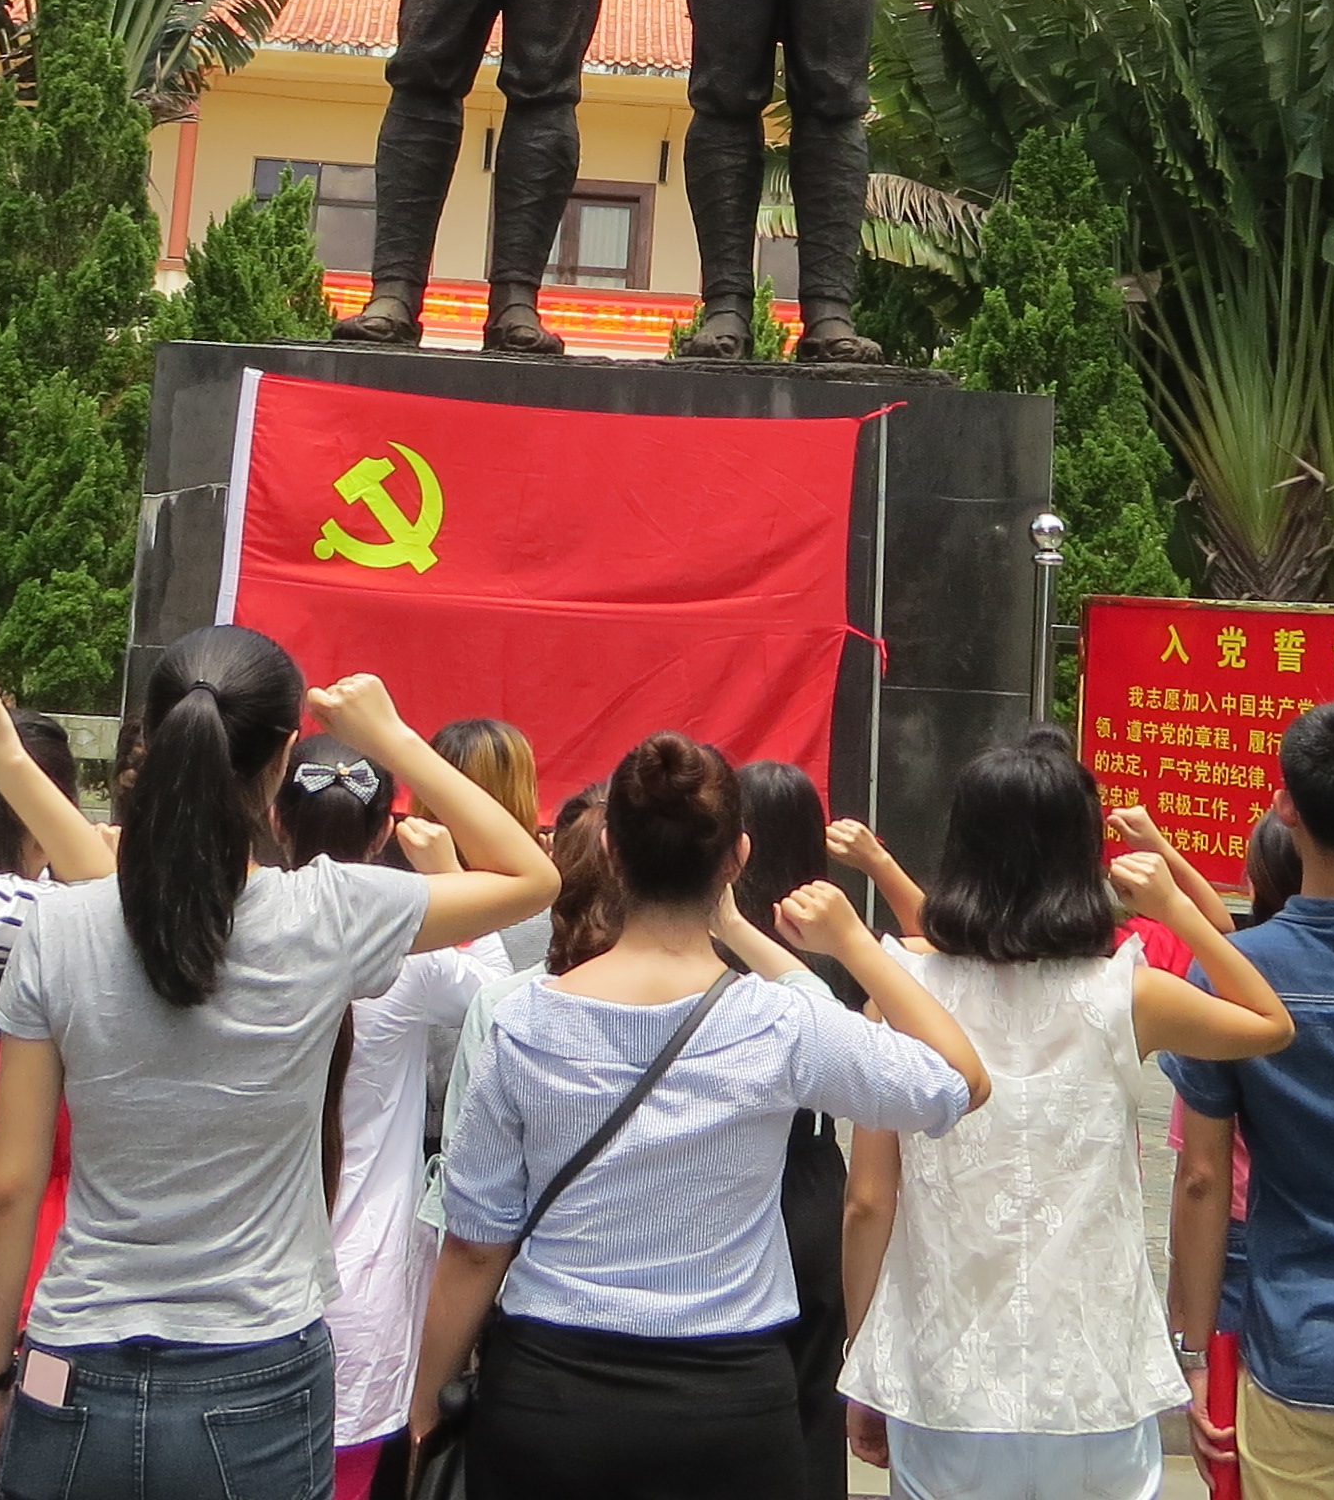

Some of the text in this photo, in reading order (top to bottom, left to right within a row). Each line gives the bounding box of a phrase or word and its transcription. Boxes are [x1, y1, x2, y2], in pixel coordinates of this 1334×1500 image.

[1094, 749, 1273, 792] 的决定，严守党的纪律，
